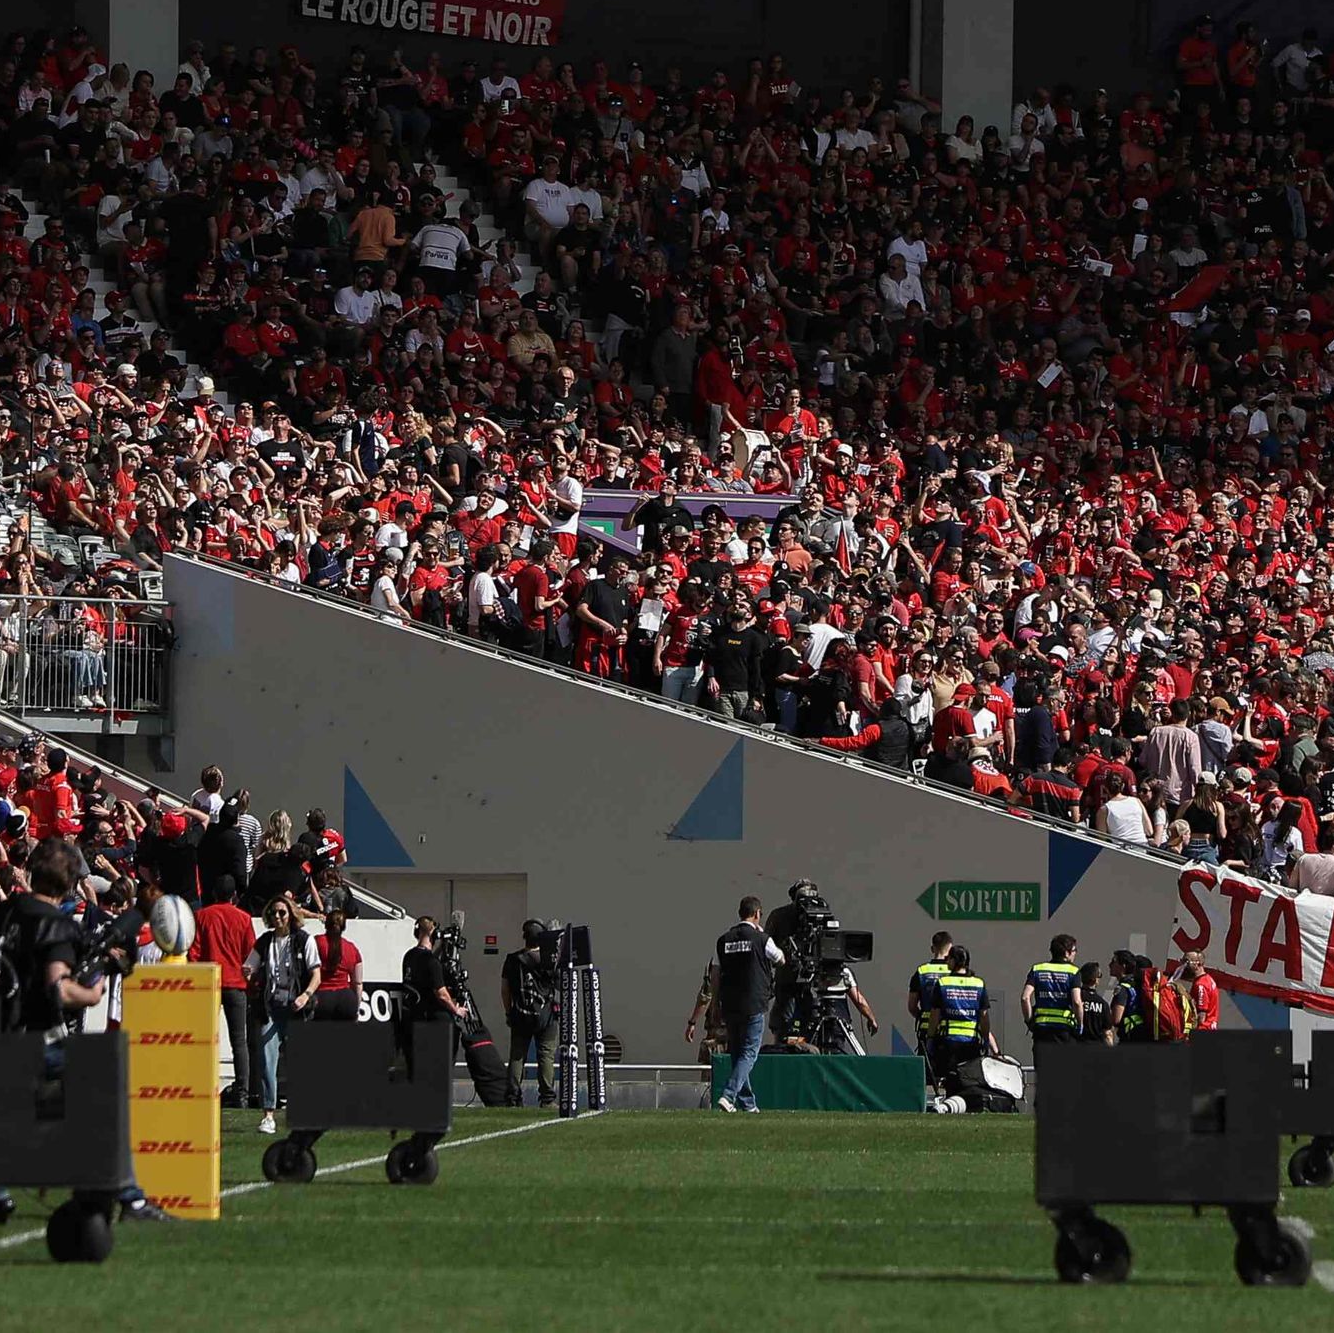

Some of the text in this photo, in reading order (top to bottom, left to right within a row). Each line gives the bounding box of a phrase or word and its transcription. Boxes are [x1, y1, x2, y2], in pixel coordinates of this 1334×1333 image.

[441, 1, 478, 37] ET
[484, 9, 553, 47] NOIR
[945, 889, 1034, 914] SORTIE
[139, 978, 195, 991] DHL
[592, 971, 600, 989] CUP
[593, 990, 603, 1039] CHAMPIONS
[139, 1032, 195, 1045] DHL
[139, 1086, 195, 1099] DHL
[139, 1141, 195, 1153] DHL
